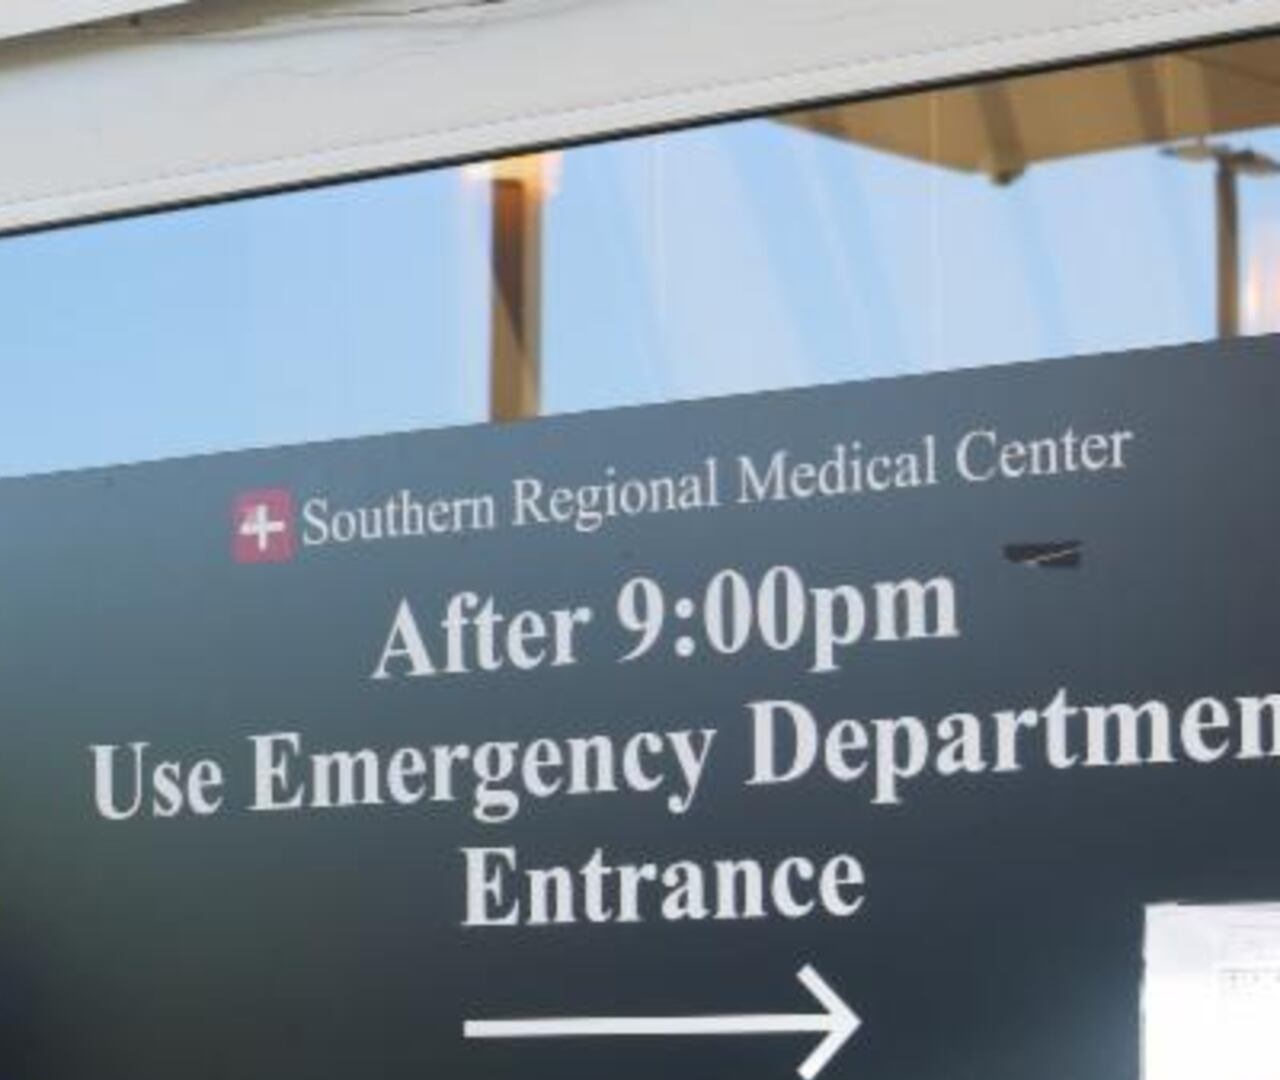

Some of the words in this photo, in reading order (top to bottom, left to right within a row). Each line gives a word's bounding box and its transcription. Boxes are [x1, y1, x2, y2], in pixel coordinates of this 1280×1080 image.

[302, 490, 496, 546] Southern
[511, 457, 723, 533] Regional
[737, 434, 939, 503] Medical
[955, 427, 1134, 482] Center
[371, 592, 593, 679] After
[616, 565, 960, 673] 9:00pm
[90, 742, 224, 820] Use
[248, 728, 718, 823] Emergency
[744, 688, 1280, 804] Departmen
[460, 846, 865, 926] Entrance
